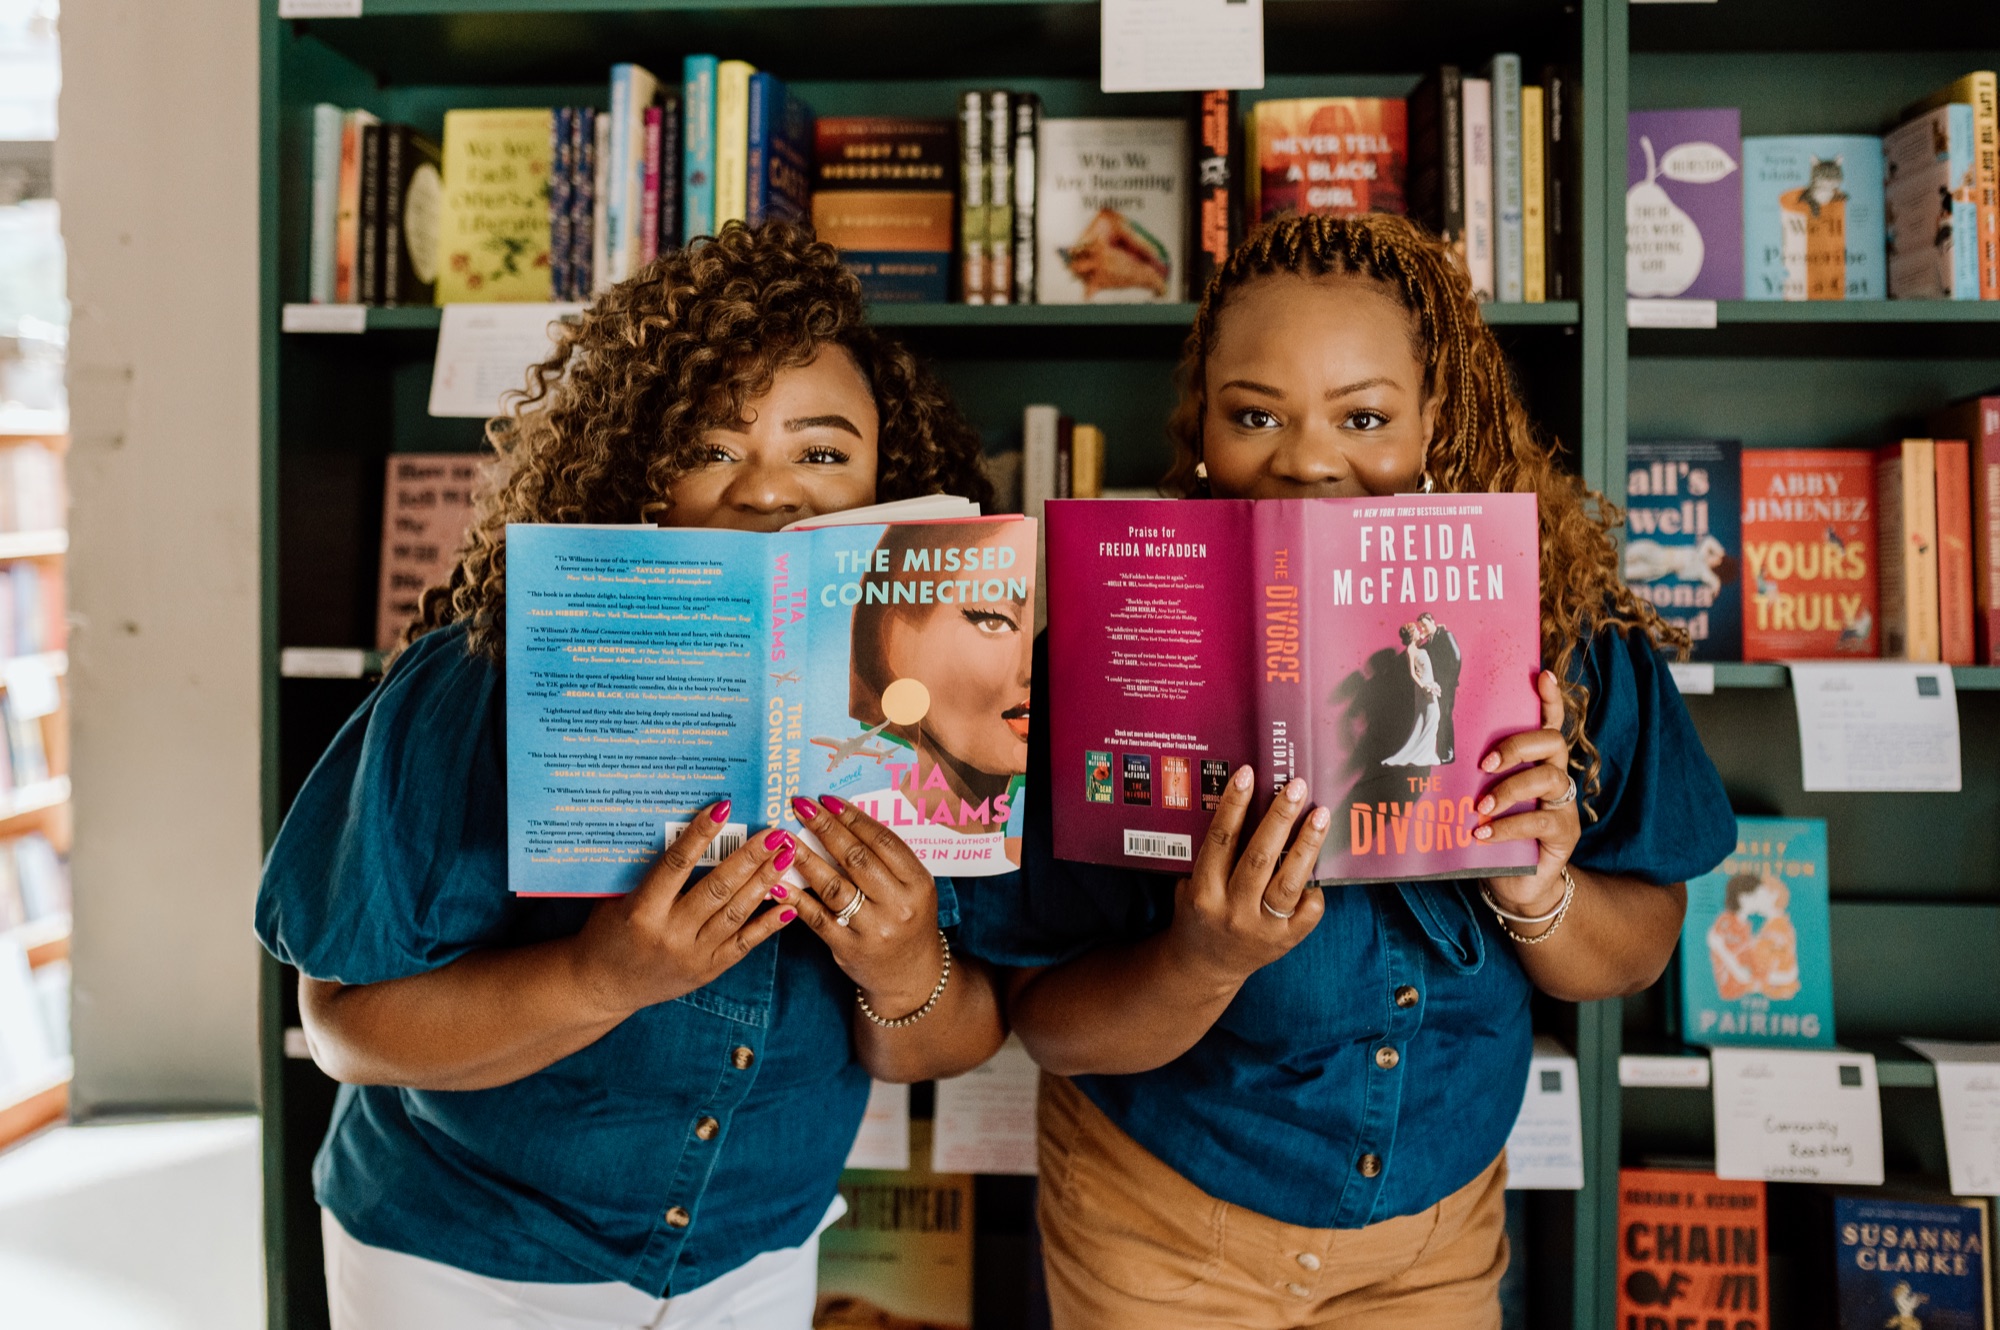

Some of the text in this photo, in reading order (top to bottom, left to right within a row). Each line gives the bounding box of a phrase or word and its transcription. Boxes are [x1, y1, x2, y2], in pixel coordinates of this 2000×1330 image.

[1272, 133, 1392, 155] NEVER TELL
[1079, 152, 1150, 169] Who We
[1286, 161, 1377, 182] A BLACK
[1091, 173, 1175, 194] Becoming
[1080, 195, 1145, 211] Matters
[1306, 186, 1357, 208] GIRL
[1789, 218, 1843, 237] We'll
[1763, 246, 1868, 267] Prescribe
[1761, 276, 1804, 296] You
[1831, 277, 1870, 296] Cat
[1628, 461, 1710, 497] all's
[1768, 472, 1843, 497] ABBY
[1352, 505, 1484, 518] #1 NEW YORK TIMES BESTSELLING AUTHOR
[1628, 499, 1709, 535] well
[1742, 497, 1870, 523] JIMENEZ
[1128, 526, 1176, 538] Praise for
[1360, 522, 1477, 562] FREIDA
[568, 555, 594, 563] Williams
[629, 558, 641, 566] very
[642, 557, 654, 565] best
[709, 559, 724, 567] have.
[834, 546, 1016, 574] THE MISSED
[1099, 542, 1207, 558] FREIDA McFADDEN
[1745, 541, 1867, 581] YOURS
[581, 566, 605, 574] auto-buy
[668, 567, 701, 576] JENKINS
[1273, 549, 1288, 579] THE
[820, 576, 1027, 607] CONNECTION
[1333, 564, 1504, 606] McFADDEN
[573, 591, 595, 599] absolute
[619, 593, 646, 602] balancing
[730, 597, 751, 605] searing
[771, 552, 790, 662] WILLIAMS
[789, 587, 808, 625] TIA
[1753, 592, 1863, 631] TRULY
[1265, 584, 1300, 685] DIVORCE
[786, 703, 803, 741] THE
[1104, 736, 1111, 744] #1
[1111, 737, 1120, 745] New
[1129, 738, 1140, 746] Times
[1140, 740, 1162, 749] bestselling
[1162, 741, 1175, 749] author
[1175, 741, 1188, 750] Freida
[1114, 728, 1127, 737] Check
[1144, 730, 1171, 741] mind-bending
[1171, 732, 1187, 741] thrillers
[1187, 733, 1197, 741] from
[1272, 720, 1287, 767] FREIDA
[829, 765, 863, 789] a novel
[884, 762, 949, 792] TIA
[1128, 763, 1145, 772] FREIDA
[1132, 782, 1142, 791] THE
[1407, 776, 1443, 793] THE
[1164, 795, 1188, 807] TENANT
[1350, 795, 1493, 856] DIVORC
[902, 836, 1003, 846] ESTSELLING AUTHOR OF
[1735, 841, 1787, 857] ASEY
[932, 848, 992, 861] IN JUNE
[1699, 1009, 1821, 1038] PAIRING
[1625, 1220, 1758, 1266] CHAIN
[1842, 1222, 1982, 1254] SUSANNA
[1856, 1247, 1969, 1277] CLARKE
